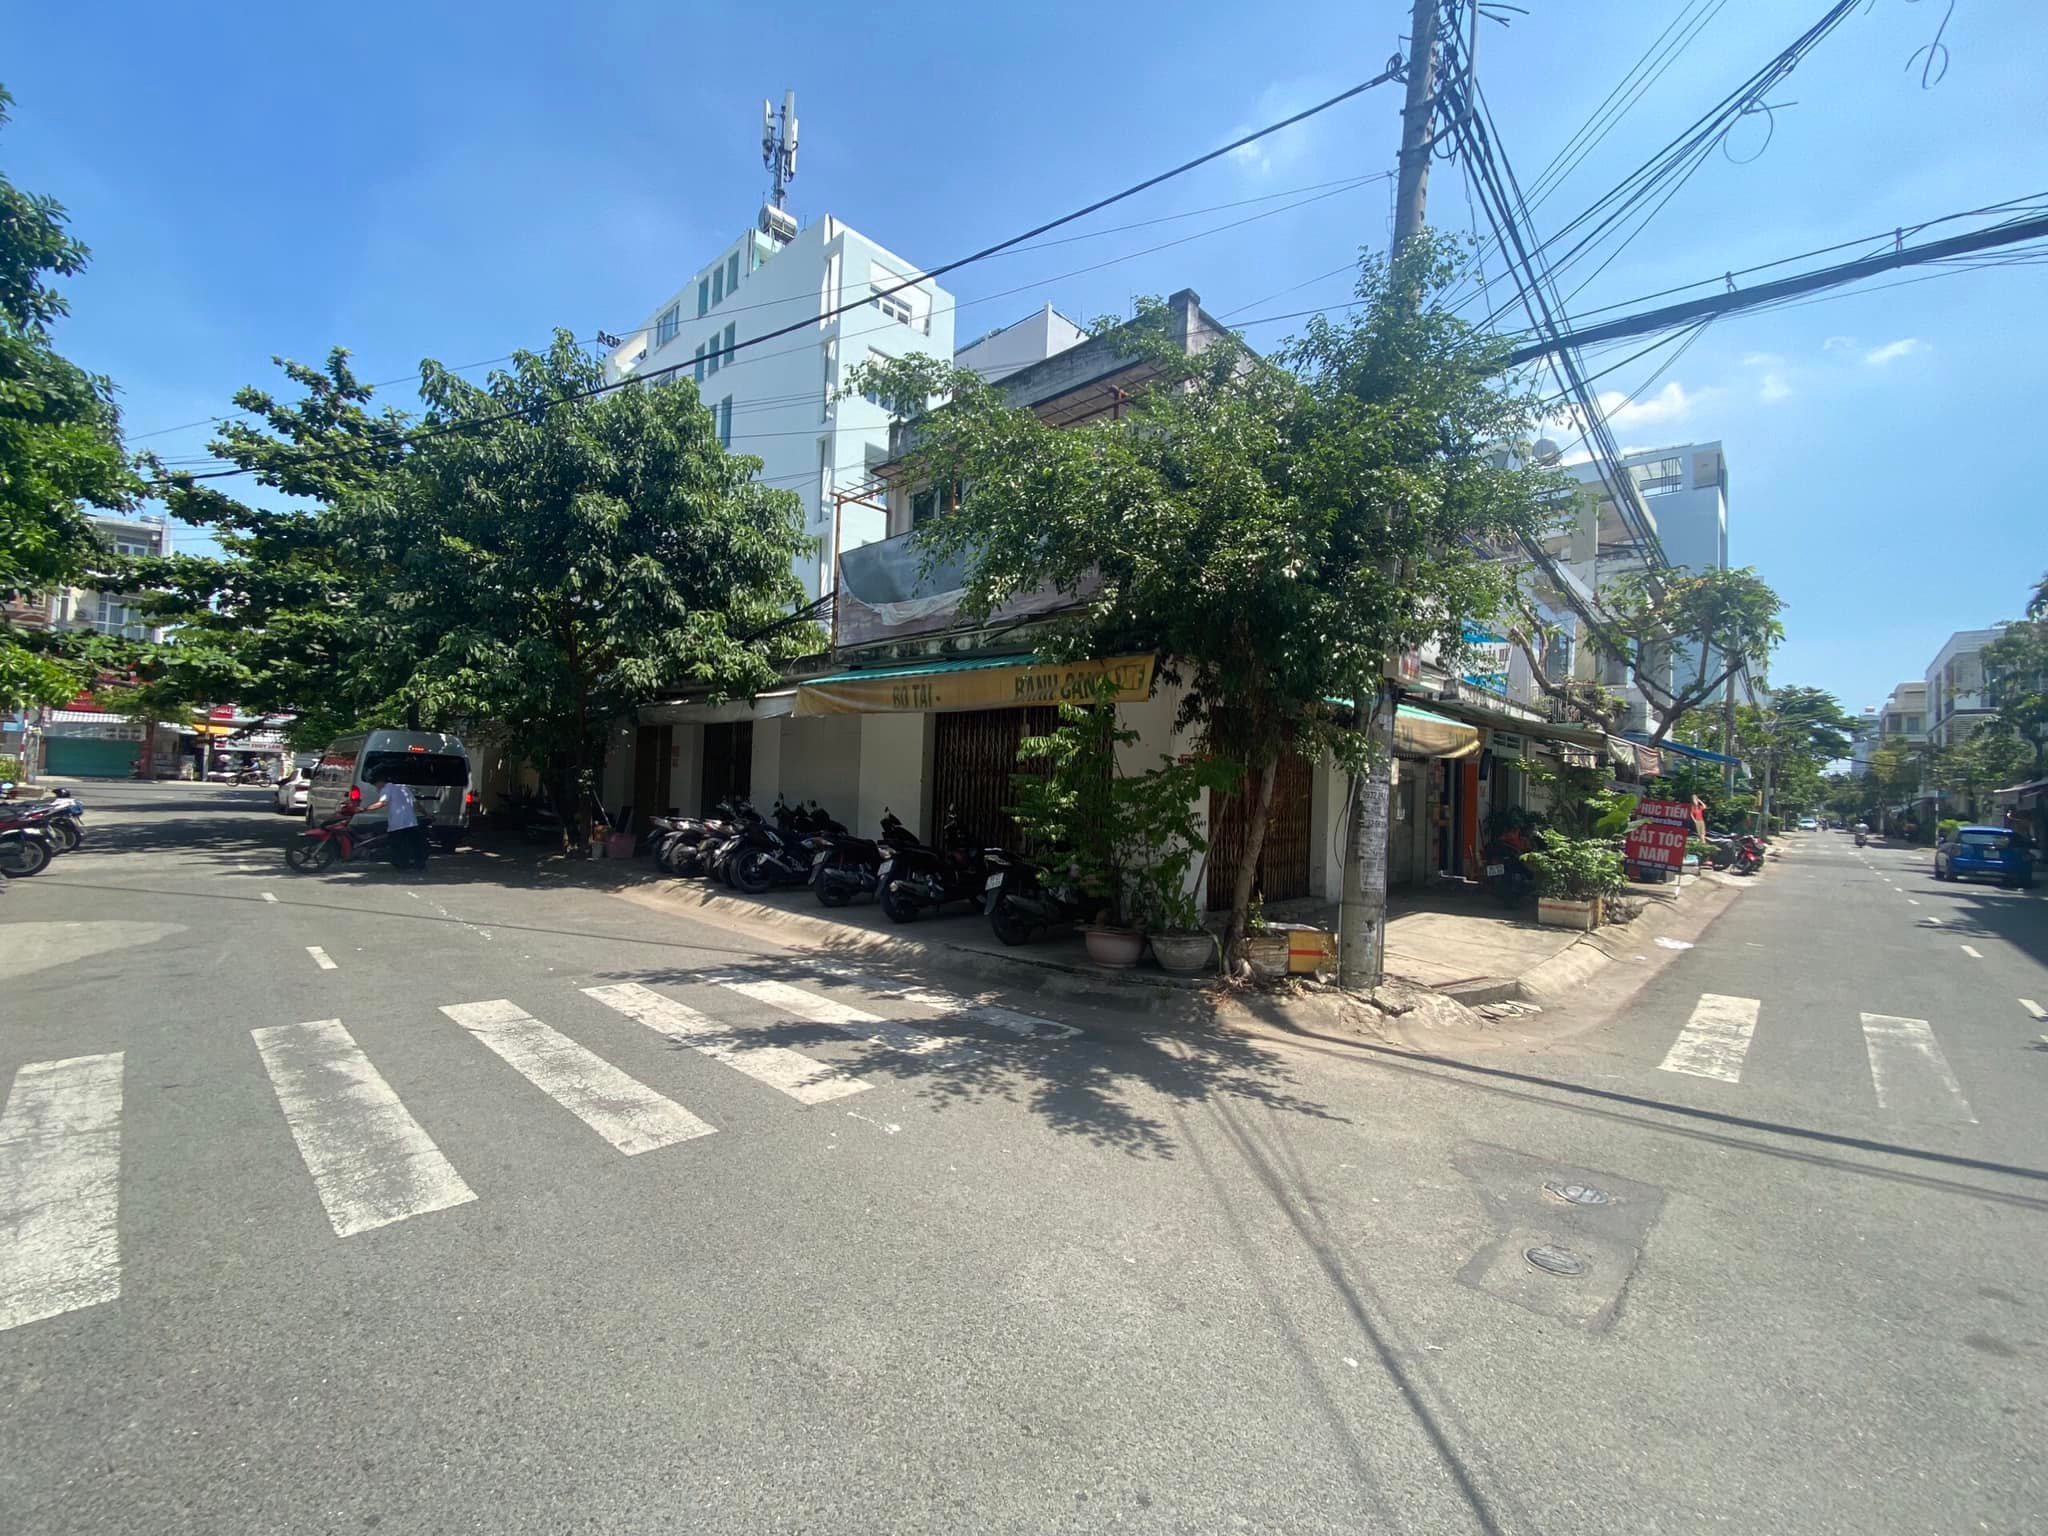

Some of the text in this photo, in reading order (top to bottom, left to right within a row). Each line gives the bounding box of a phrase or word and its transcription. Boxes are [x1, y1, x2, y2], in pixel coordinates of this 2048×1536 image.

[1630, 825, 1683, 848] CẮT TÓC
[1638, 845, 1670, 863] NAM
